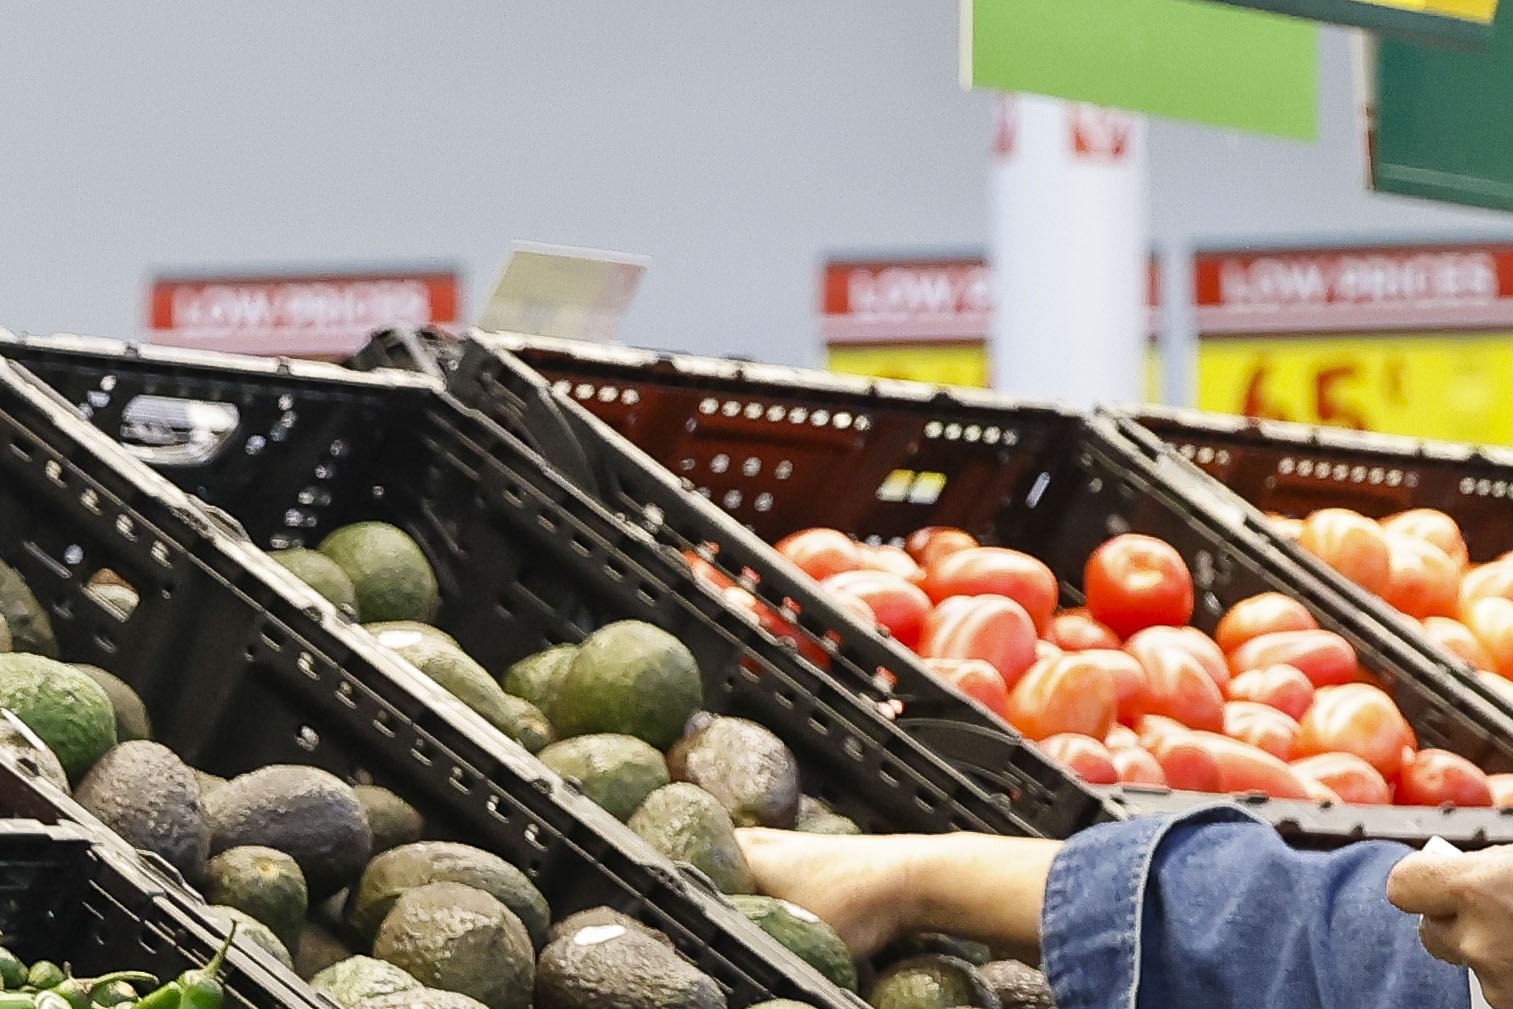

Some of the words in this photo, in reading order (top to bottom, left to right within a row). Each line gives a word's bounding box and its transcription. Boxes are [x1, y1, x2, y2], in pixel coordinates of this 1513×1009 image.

[172, 281, 270, 326] LOW
[282, 278, 429, 324] PRICES
[851, 265, 951, 312] LOW
[1221, 257, 1324, 303] LOW
[1335, 253, 1497, 300] PRICES
